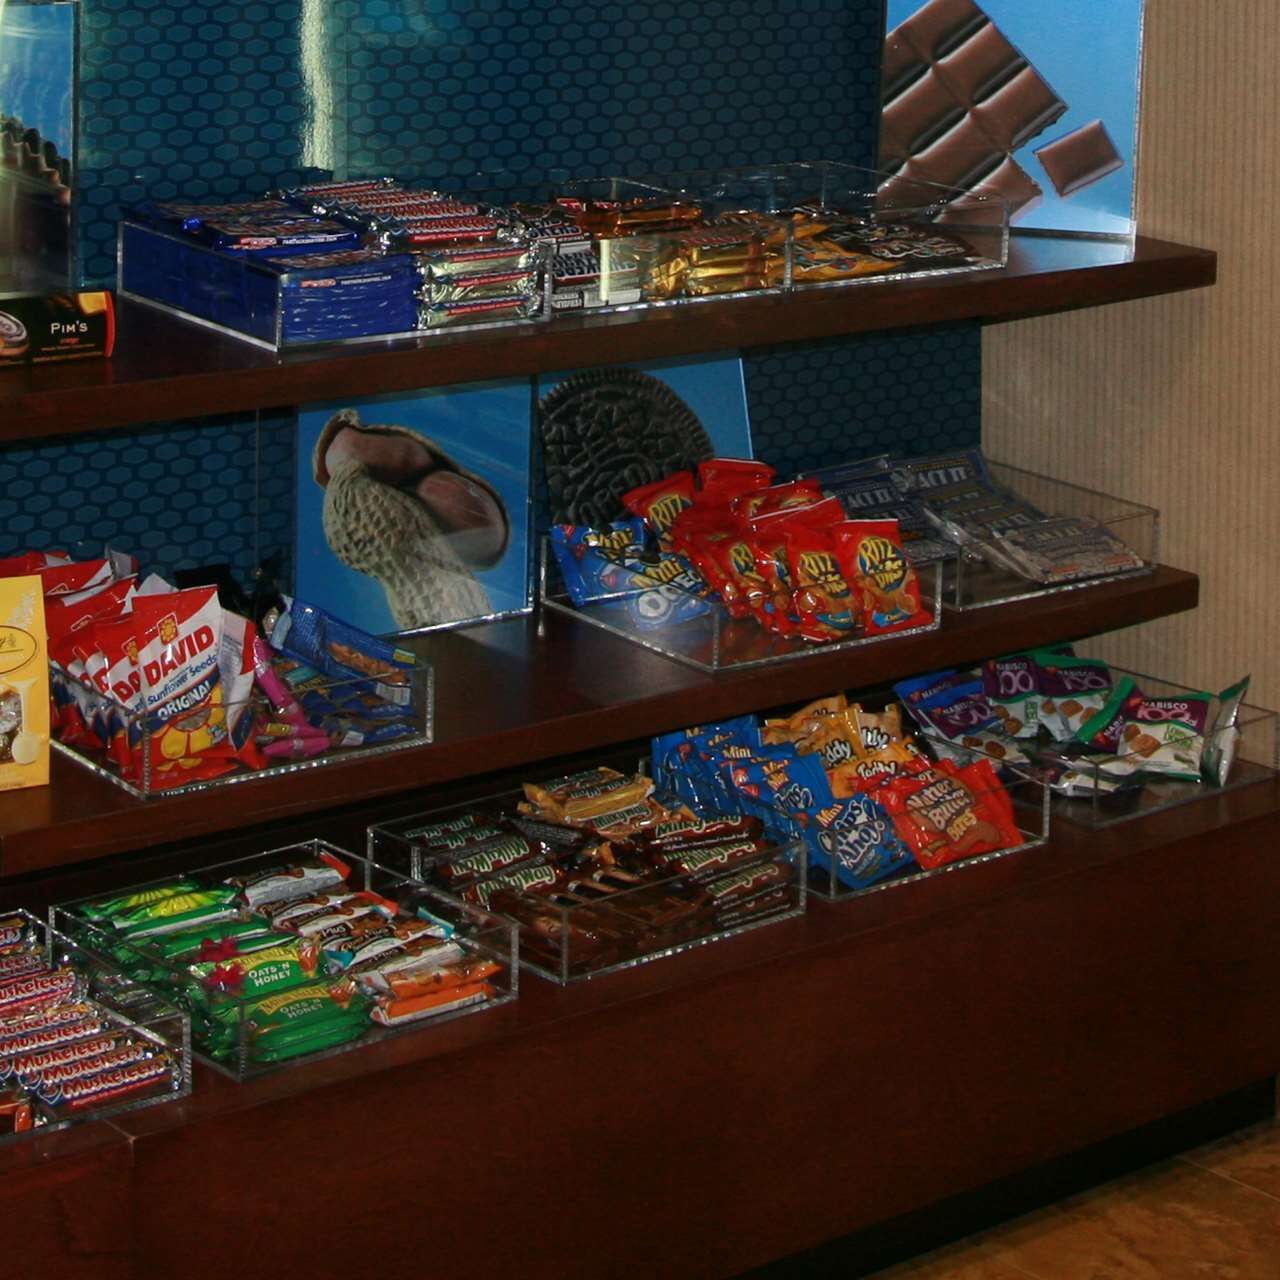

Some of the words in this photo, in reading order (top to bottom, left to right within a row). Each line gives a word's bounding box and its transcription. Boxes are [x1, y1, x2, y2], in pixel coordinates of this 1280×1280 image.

[858, 537, 897, 565] RITZ
[145, 624, 215, 686] DAVID
[157, 680, 213, 720] ORIGINAL
[247, 965, 277, 981] OATS
[253, 968, 293, 988] HONEY
[15, 1038, 117, 1076] Musketeers
[42, 1044, 144, 1086] Musketeers
[62, 1058, 166, 1099] Musketeers
